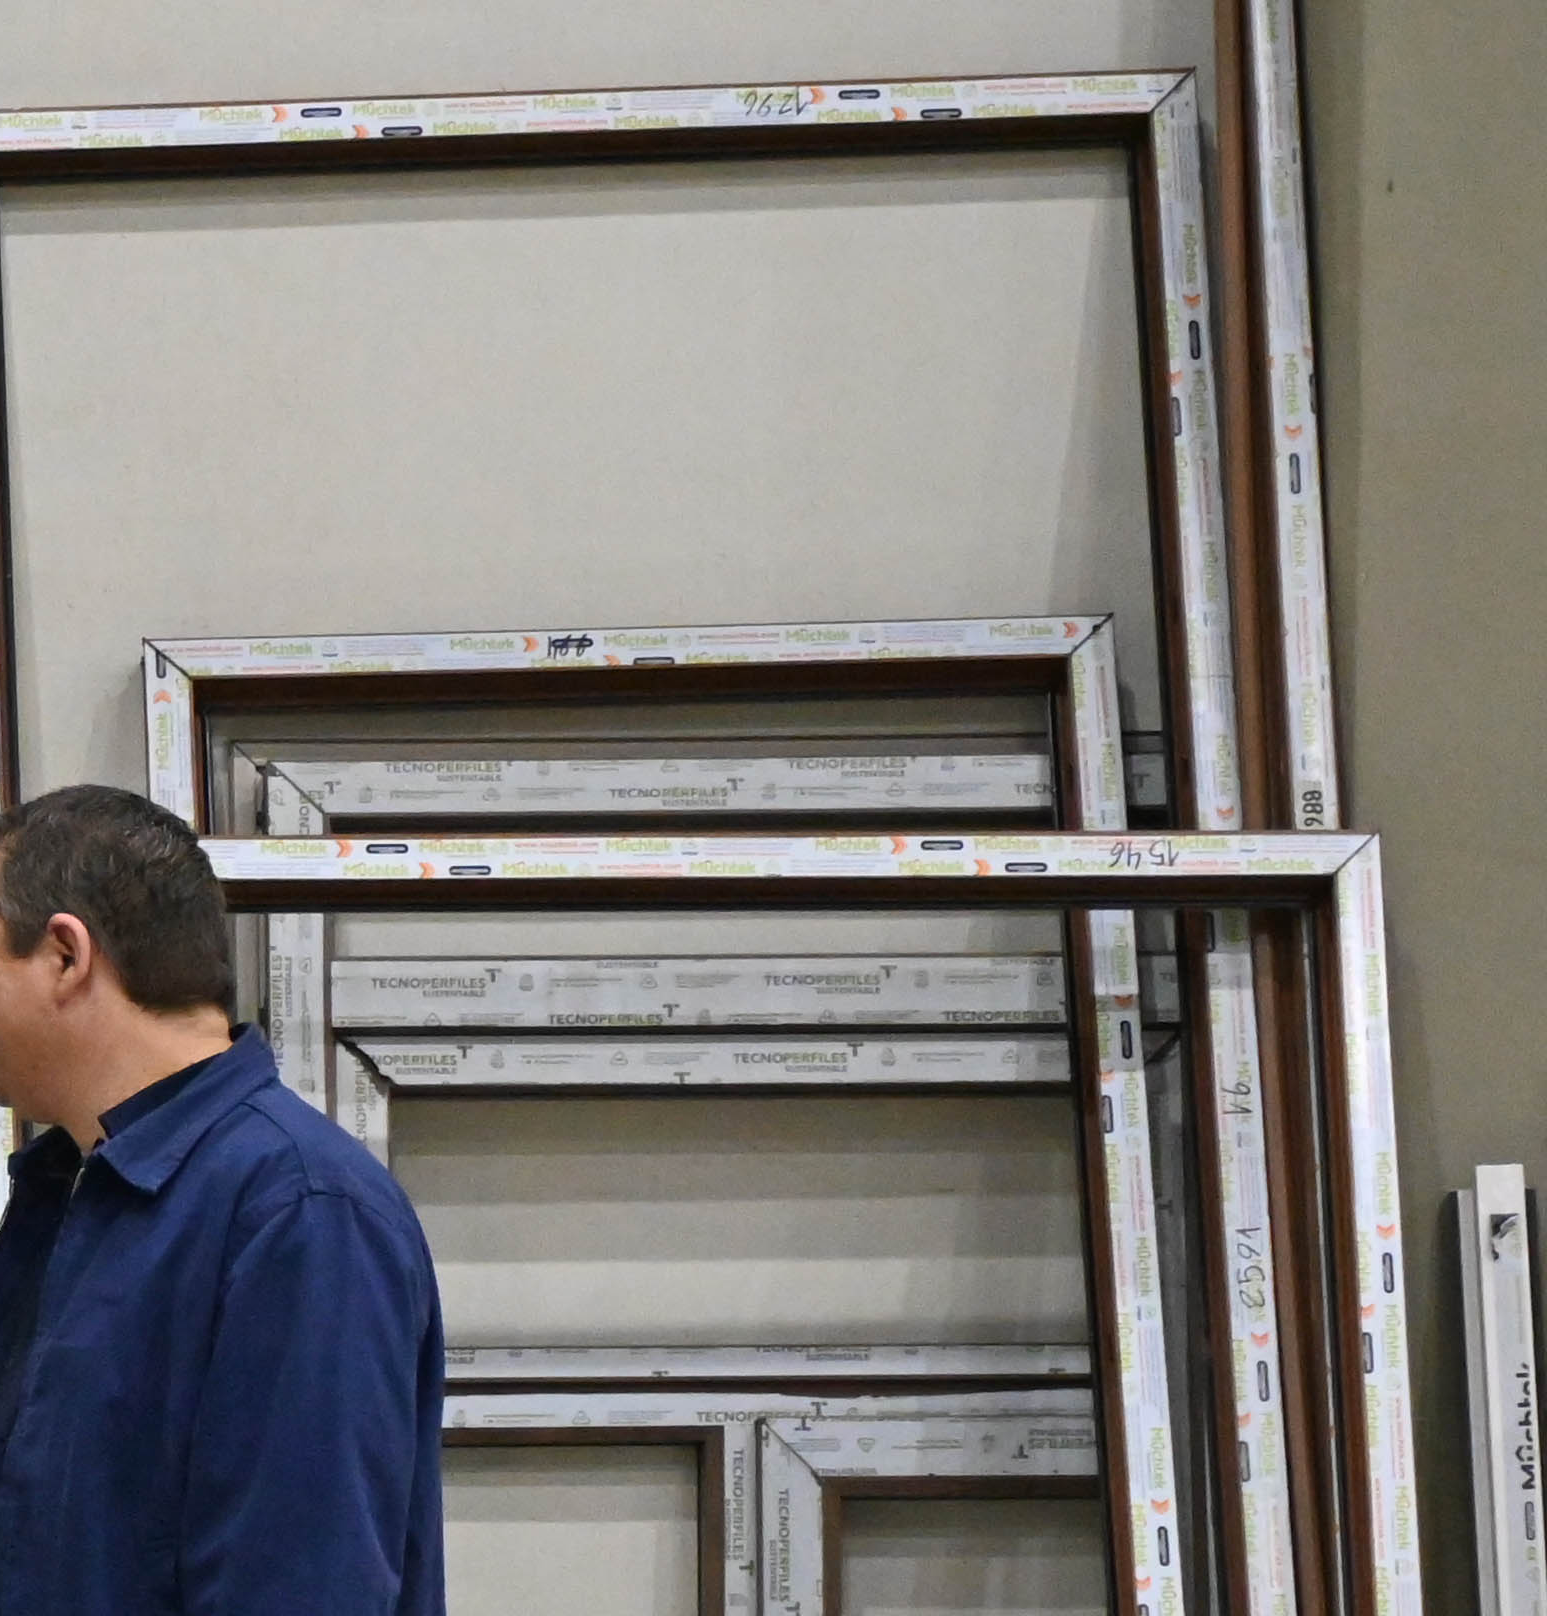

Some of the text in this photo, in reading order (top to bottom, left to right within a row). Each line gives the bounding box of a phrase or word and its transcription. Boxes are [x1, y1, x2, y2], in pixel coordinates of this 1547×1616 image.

[371, 976, 486, 990] TECNOPERFILES
[764, 974, 881, 987] TECNOPERFILES
[733, 1052, 849, 1065] TECNOPERFILES
